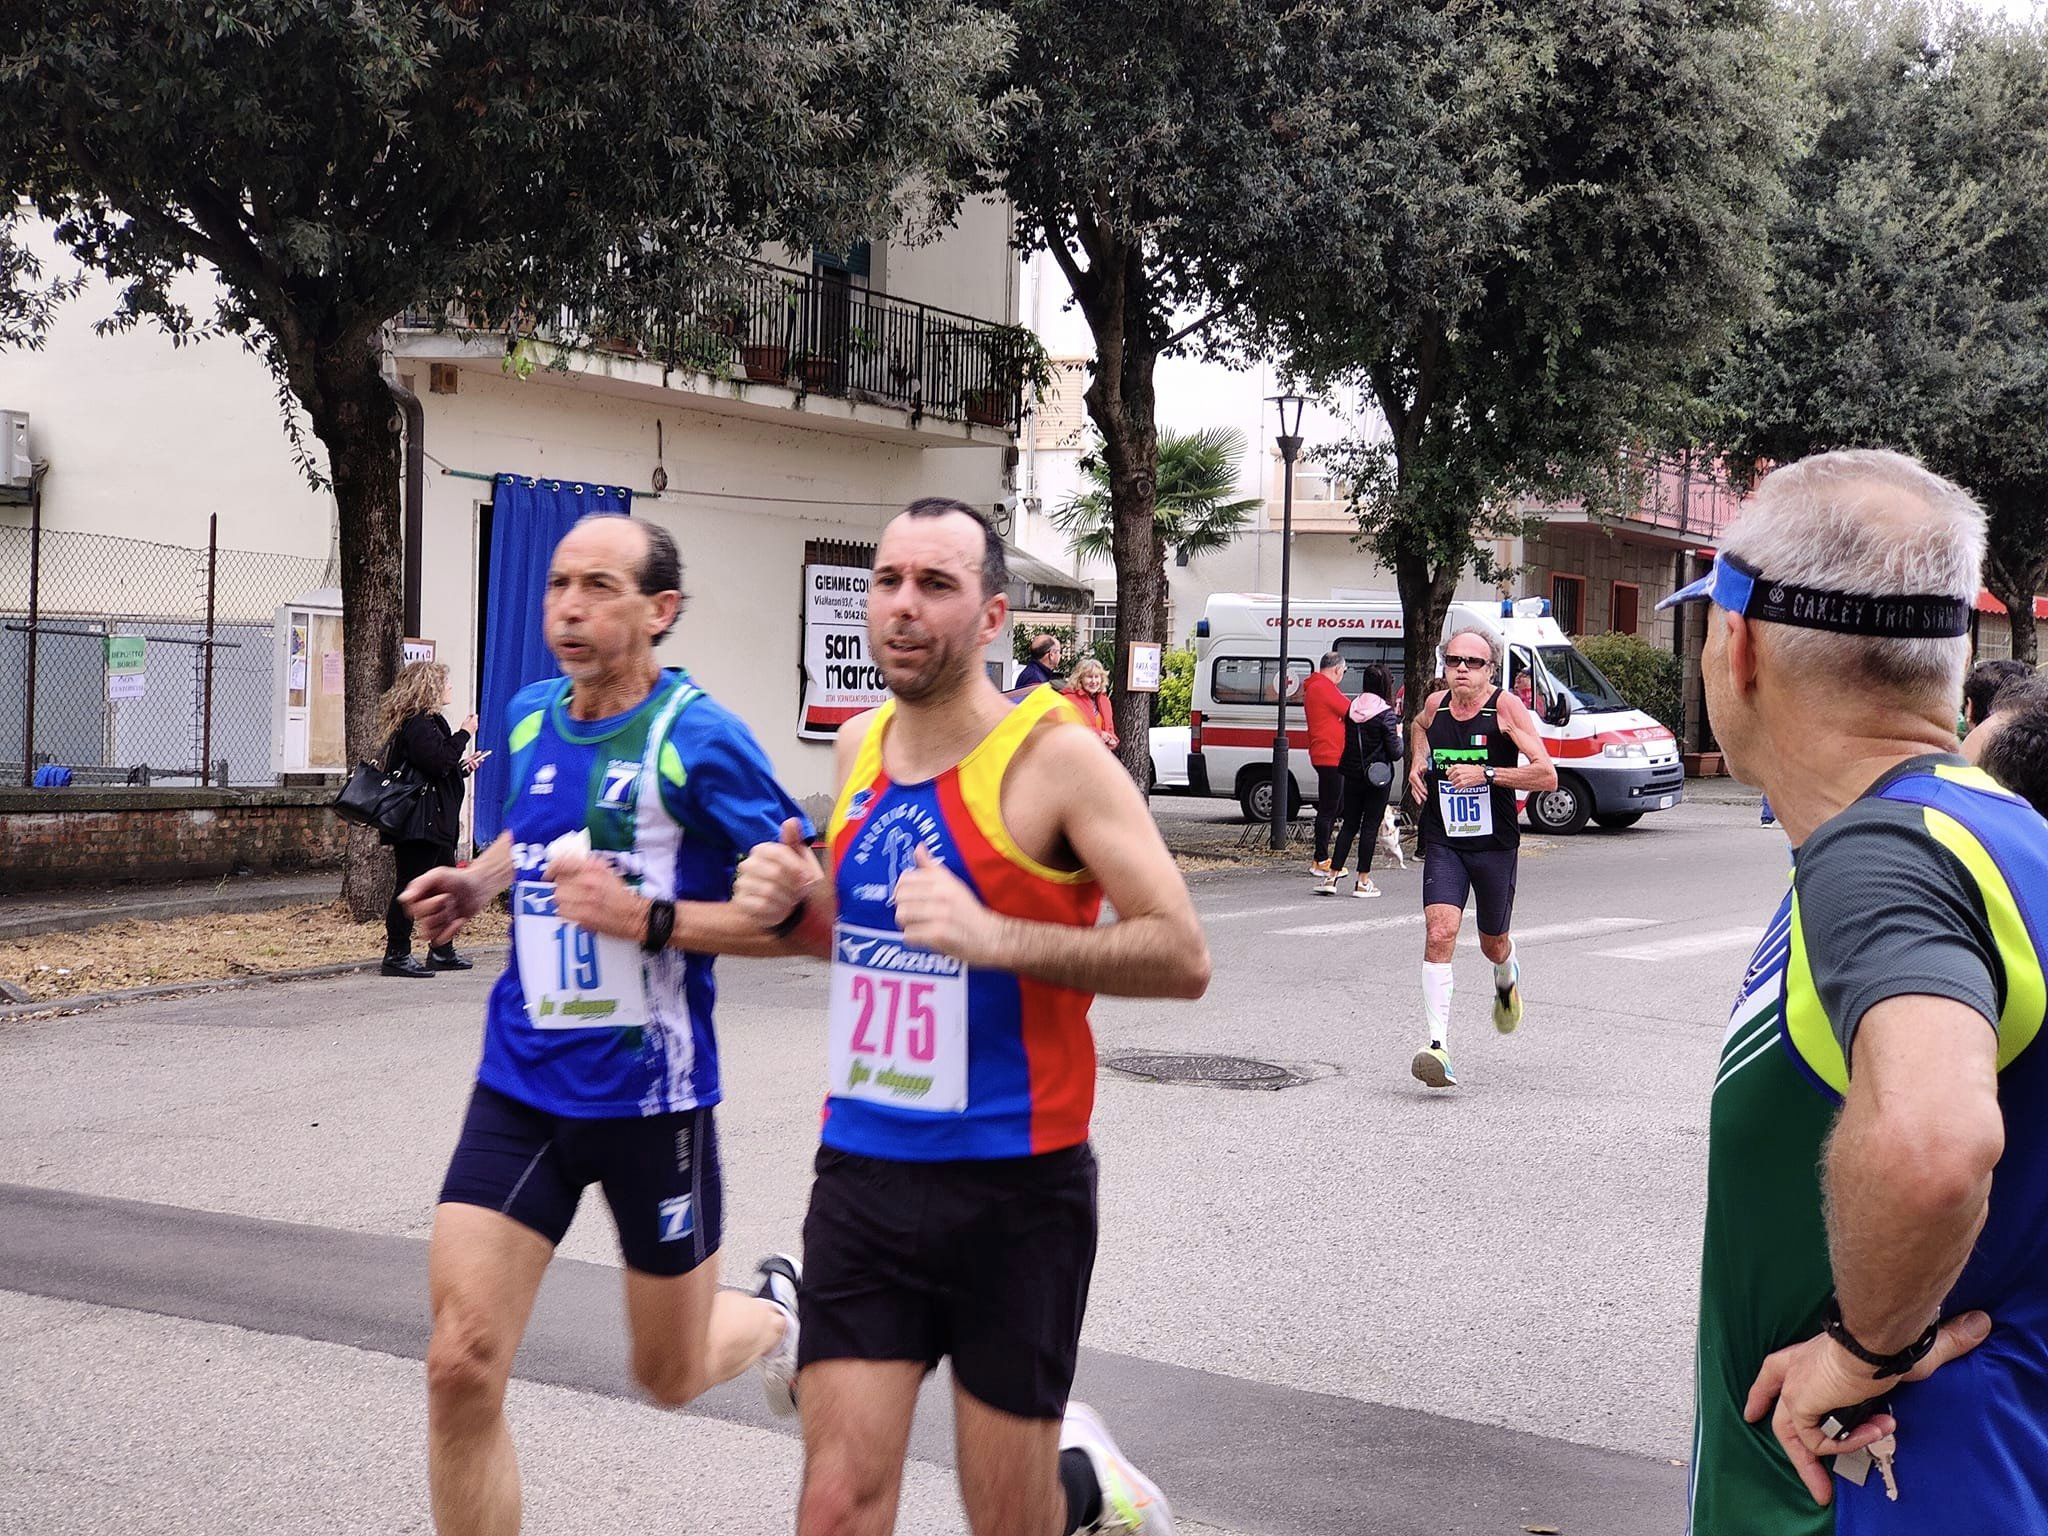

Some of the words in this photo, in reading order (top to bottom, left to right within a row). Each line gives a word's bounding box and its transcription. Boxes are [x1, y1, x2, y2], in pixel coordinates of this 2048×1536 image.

[815, 575, 851, 591] GIEMME
[1793, 593, 1865, 625] OAKLEY
[1266, 617, 1313, 628] CROCE
[1317, 618, 1365, 629] ROSSA
[1370, 619, 1402, 629] ITAL
[825, 634, 861, 660] san
[825, 664, 888, 690] marco
[1448, 796, 1481, 822] 105
[555, 922, 599, 990] 19
[851, 974, 935, 1062] 275
